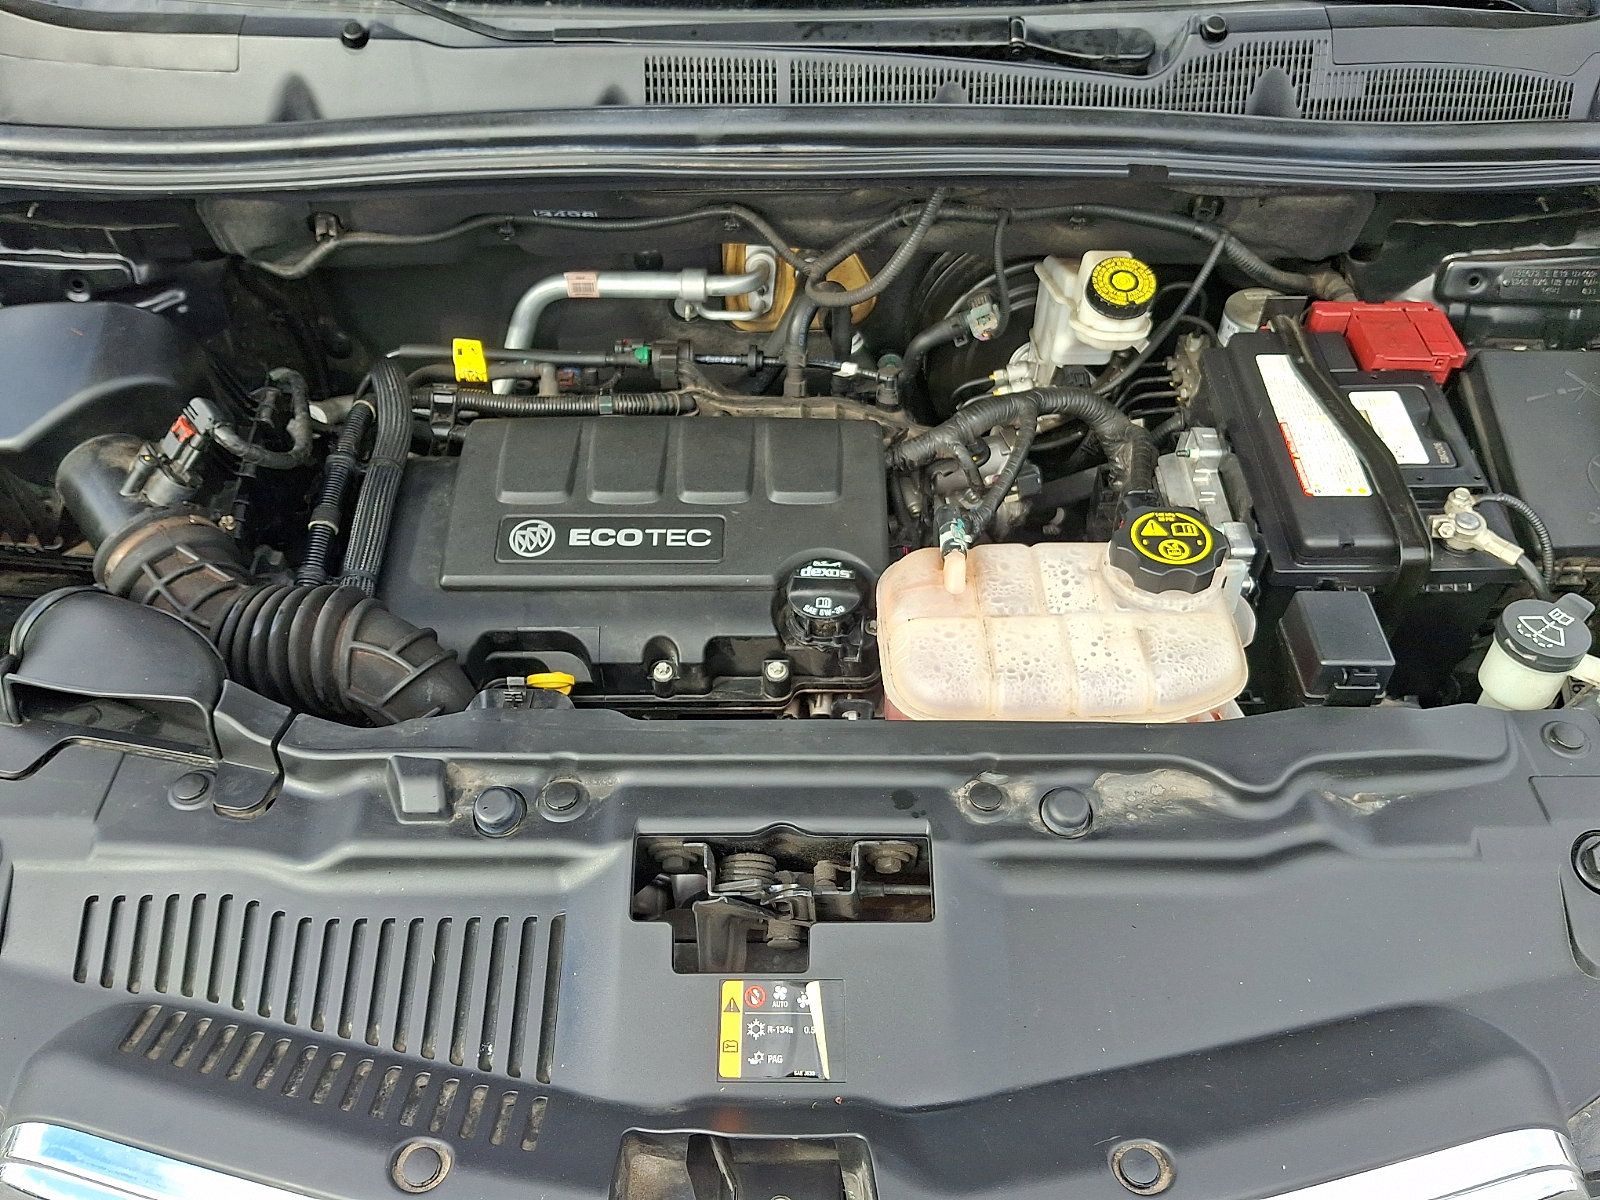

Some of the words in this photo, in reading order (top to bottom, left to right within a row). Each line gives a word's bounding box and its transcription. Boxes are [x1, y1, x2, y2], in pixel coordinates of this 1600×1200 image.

[568, 527, 712, 547] ECOTEC
[800, 565, 851, 579] dexos
[802, 604, 818, 616] SAE
[818, 604, 846, 617] 5W-30
[772, 1000, 789, 1008] AUTO
[767, 1025, 794, 1035] R-134a
[767, 1054, 783, 1064] PAG
